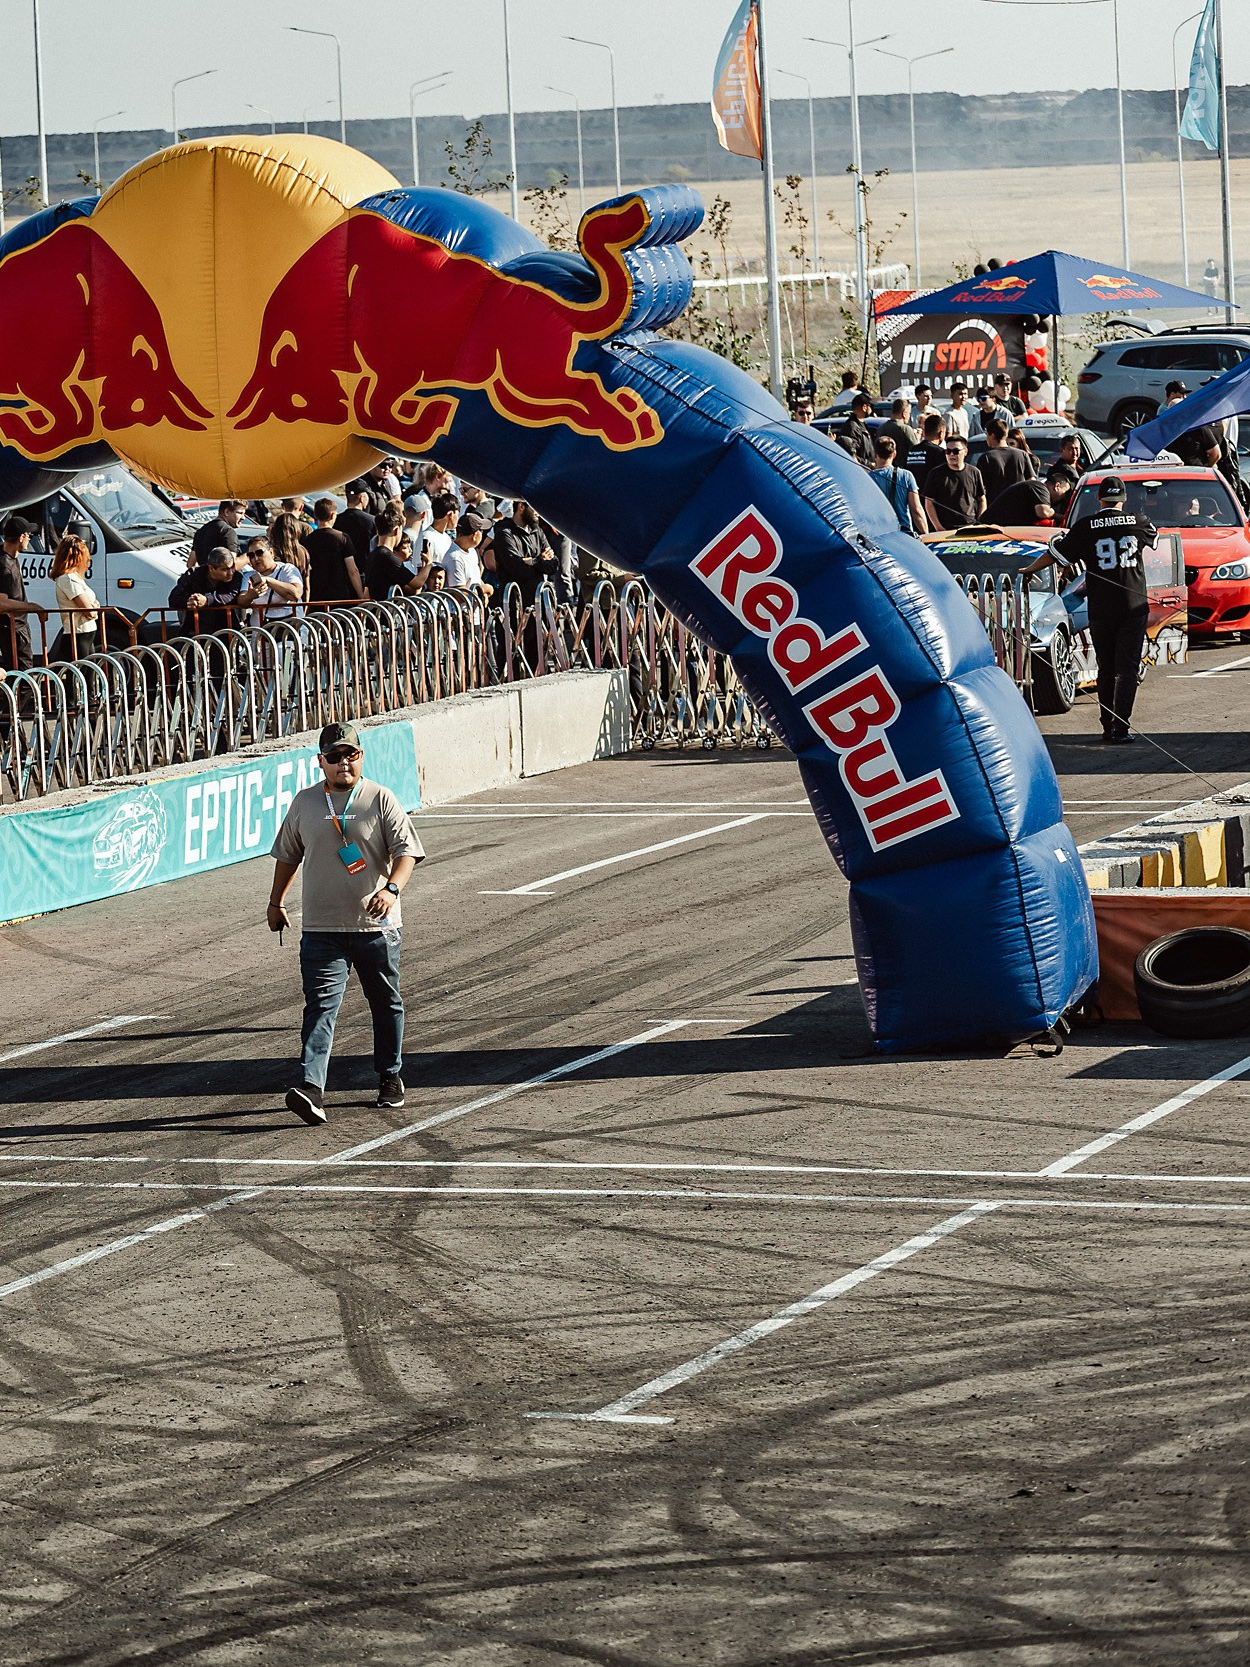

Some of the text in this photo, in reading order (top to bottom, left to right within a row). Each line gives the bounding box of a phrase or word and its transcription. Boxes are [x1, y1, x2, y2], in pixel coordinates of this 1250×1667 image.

[950, 291, 1026, 302] Red Bull
[901, 341, 987, 373] PIT STOP
[901, 373, 1003, 391] ШИНОМОНТА
[1034, 418, 1058, 426] region
[1090, 516, 1137, 529] LOS ANGELES
[1095, 535, 1139, 571] 92
[688, 503, 961, 853] Red Bull
